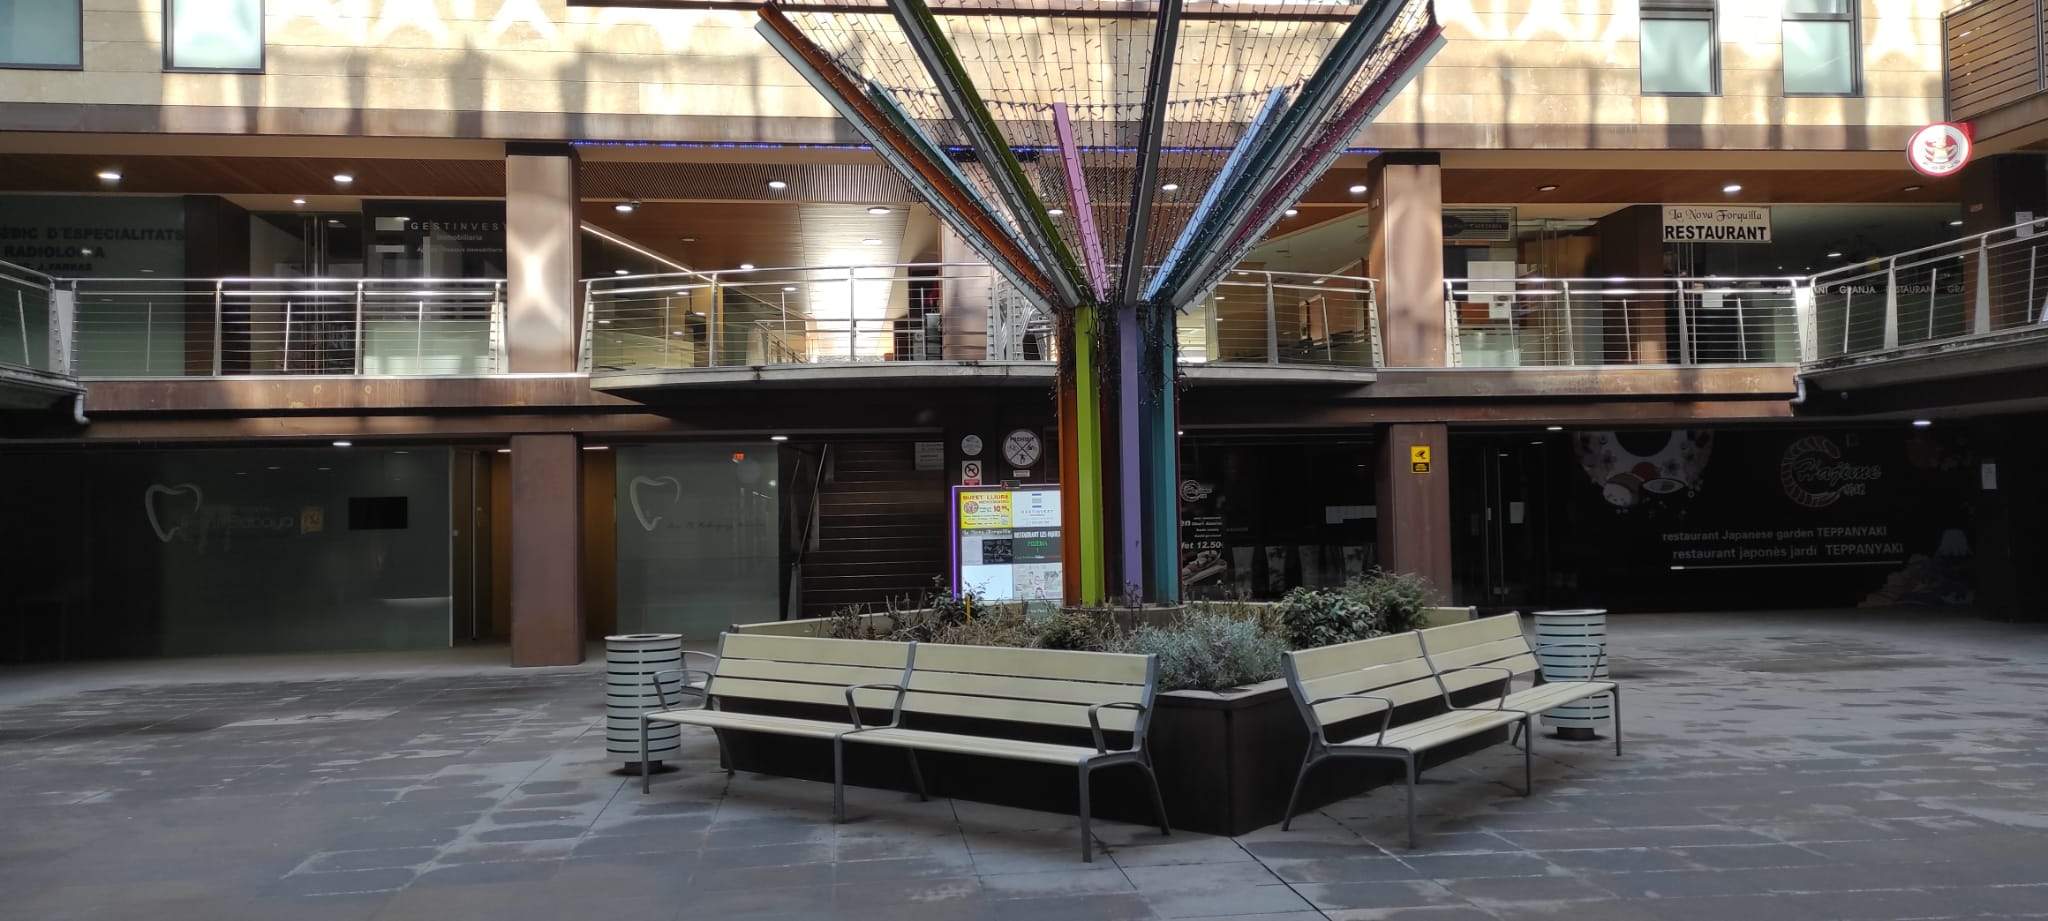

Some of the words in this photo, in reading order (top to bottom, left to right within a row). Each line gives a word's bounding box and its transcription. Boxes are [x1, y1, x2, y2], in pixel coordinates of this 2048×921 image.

[1688, 208, 1713, 222] Nova
[1716, 209, 1762, 222] Forquilla
[1664, 225, 1767, 240] RESTAURANT
[1662, 532, 1719, 542] restaurant
[1721, 530, 1774, 542] Japanese
[1776, 529, 1814, 541] garden
[1816, 526, 1888, 537] TEPPANYAKI
[1672, 548, 1736, 560] restaurant
[1824, 543, 1904, 556] TEPPANYAKI
